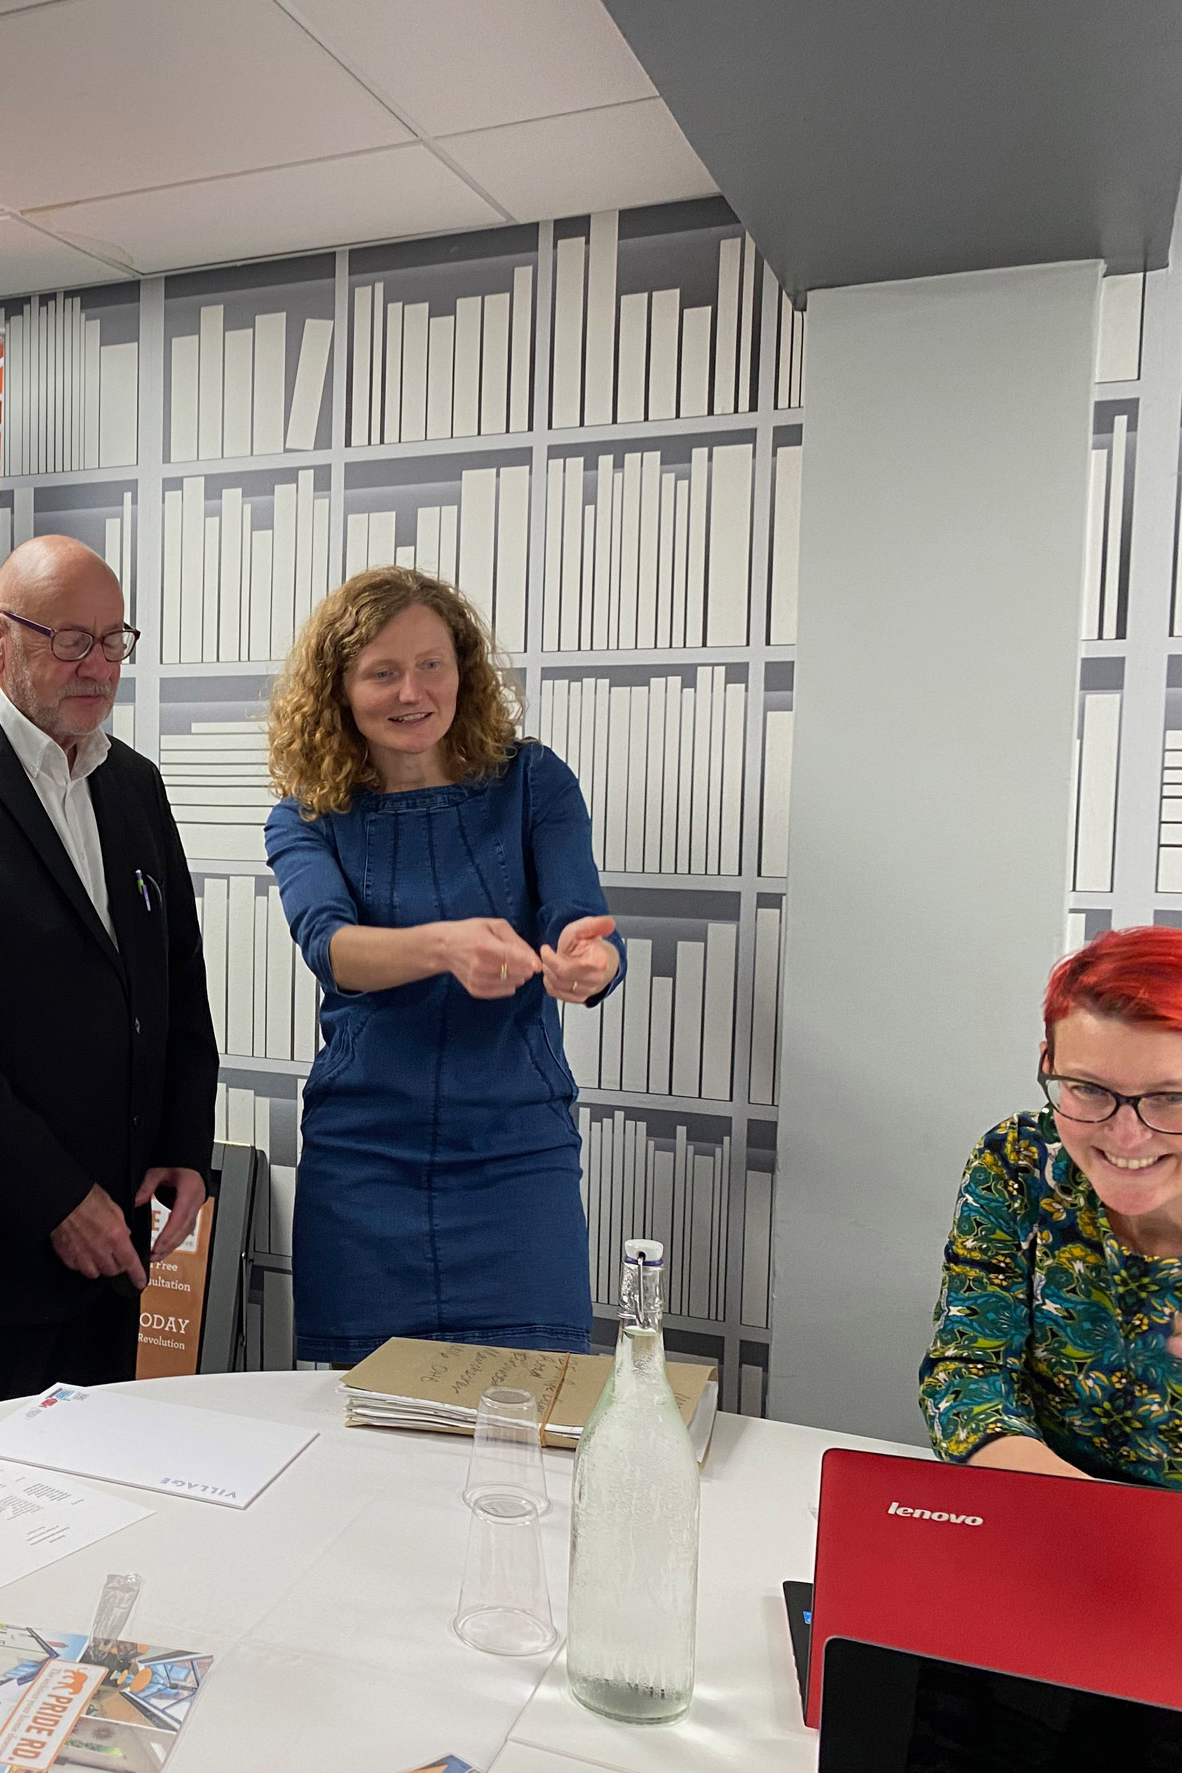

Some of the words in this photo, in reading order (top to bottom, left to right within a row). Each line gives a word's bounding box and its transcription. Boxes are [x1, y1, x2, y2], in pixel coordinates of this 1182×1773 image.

[139, 1312, 189, 1334] ODAY
[138, 1332, 185, 1350] Revolution
[159, 1477, 237, 1499] VILLAGE
[887, 1501, 984, 1527] lenovo
[26, 1693, 74, 1737] PRIDE
[7, 1737, 47, 1761] RD.
